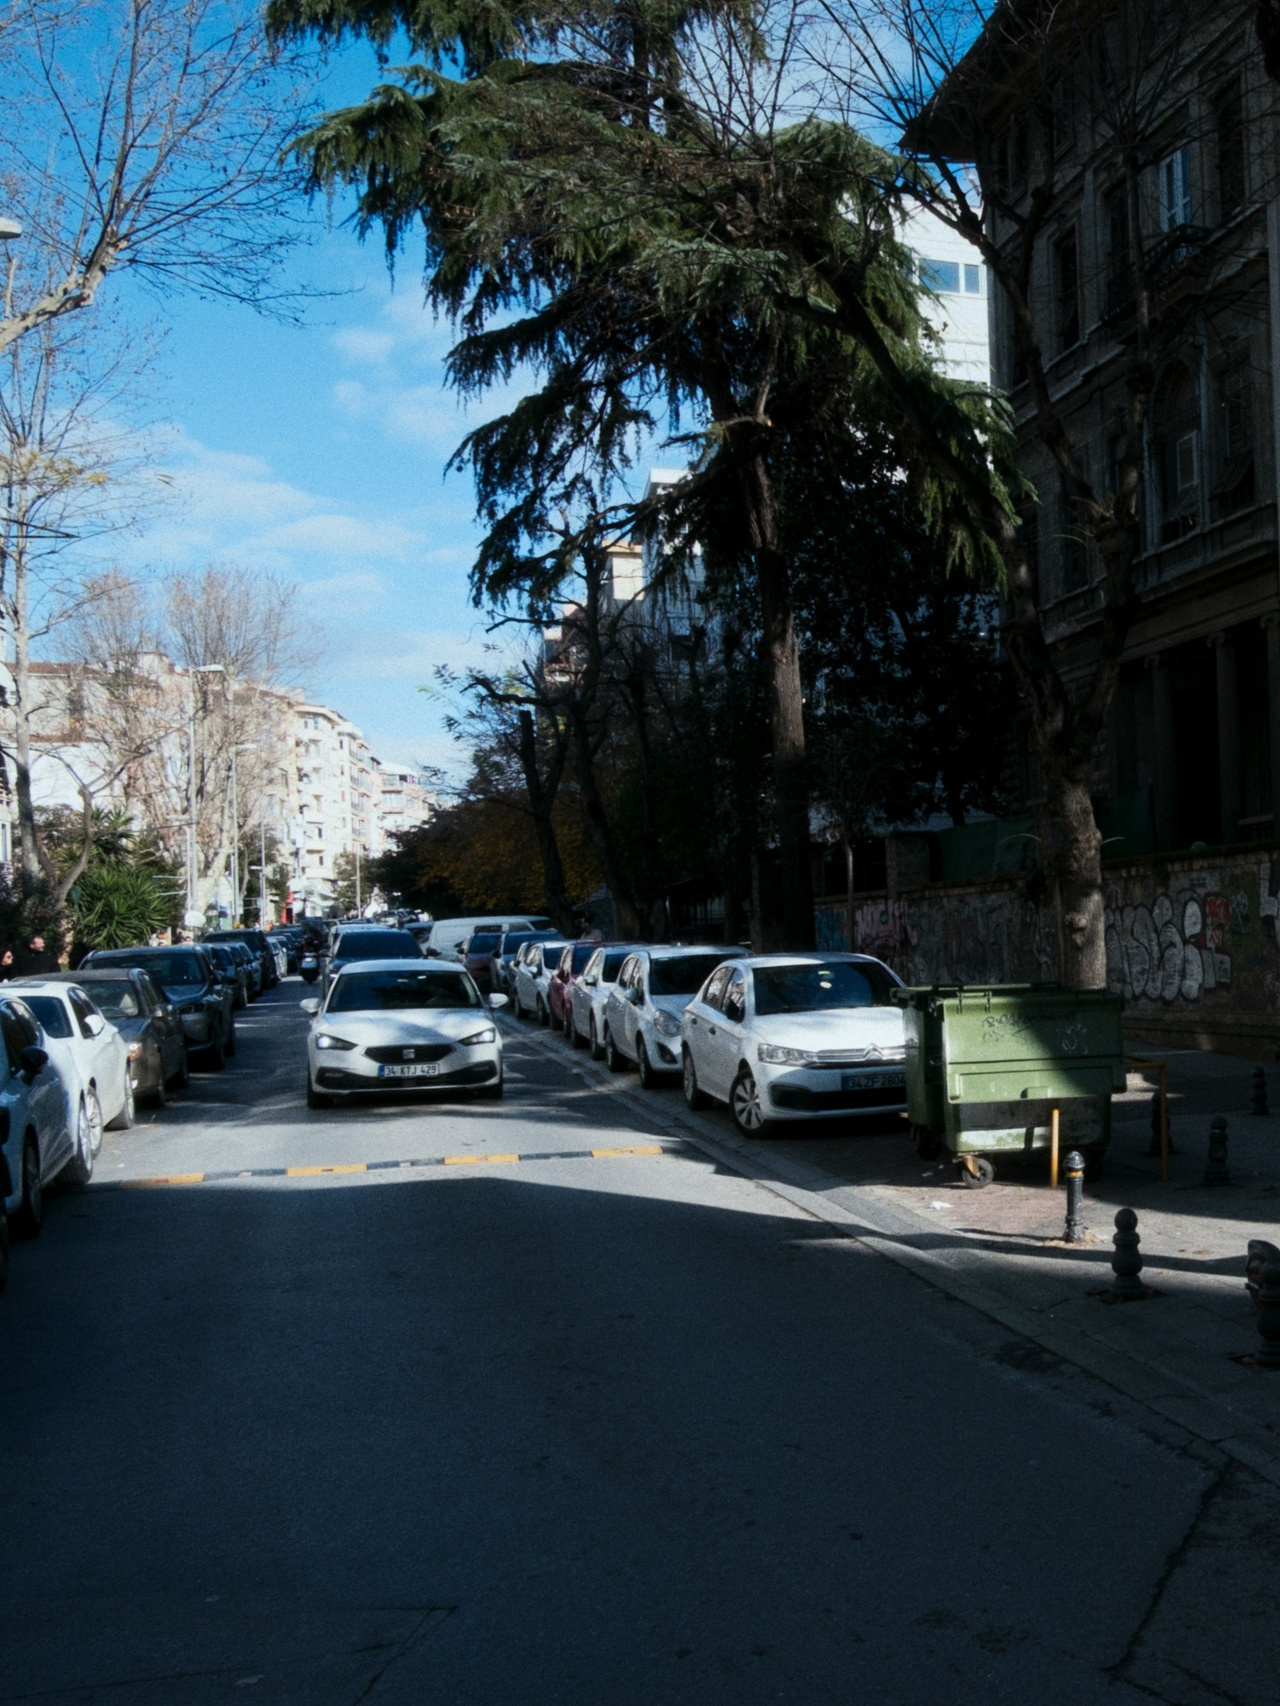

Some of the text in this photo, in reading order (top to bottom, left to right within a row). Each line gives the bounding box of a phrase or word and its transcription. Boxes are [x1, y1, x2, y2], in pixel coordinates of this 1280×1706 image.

[386, 1066, 396, 1076] 34
[849, 1077, 862, 1088] 34
[863, 1077, 879, 1088] ZF
